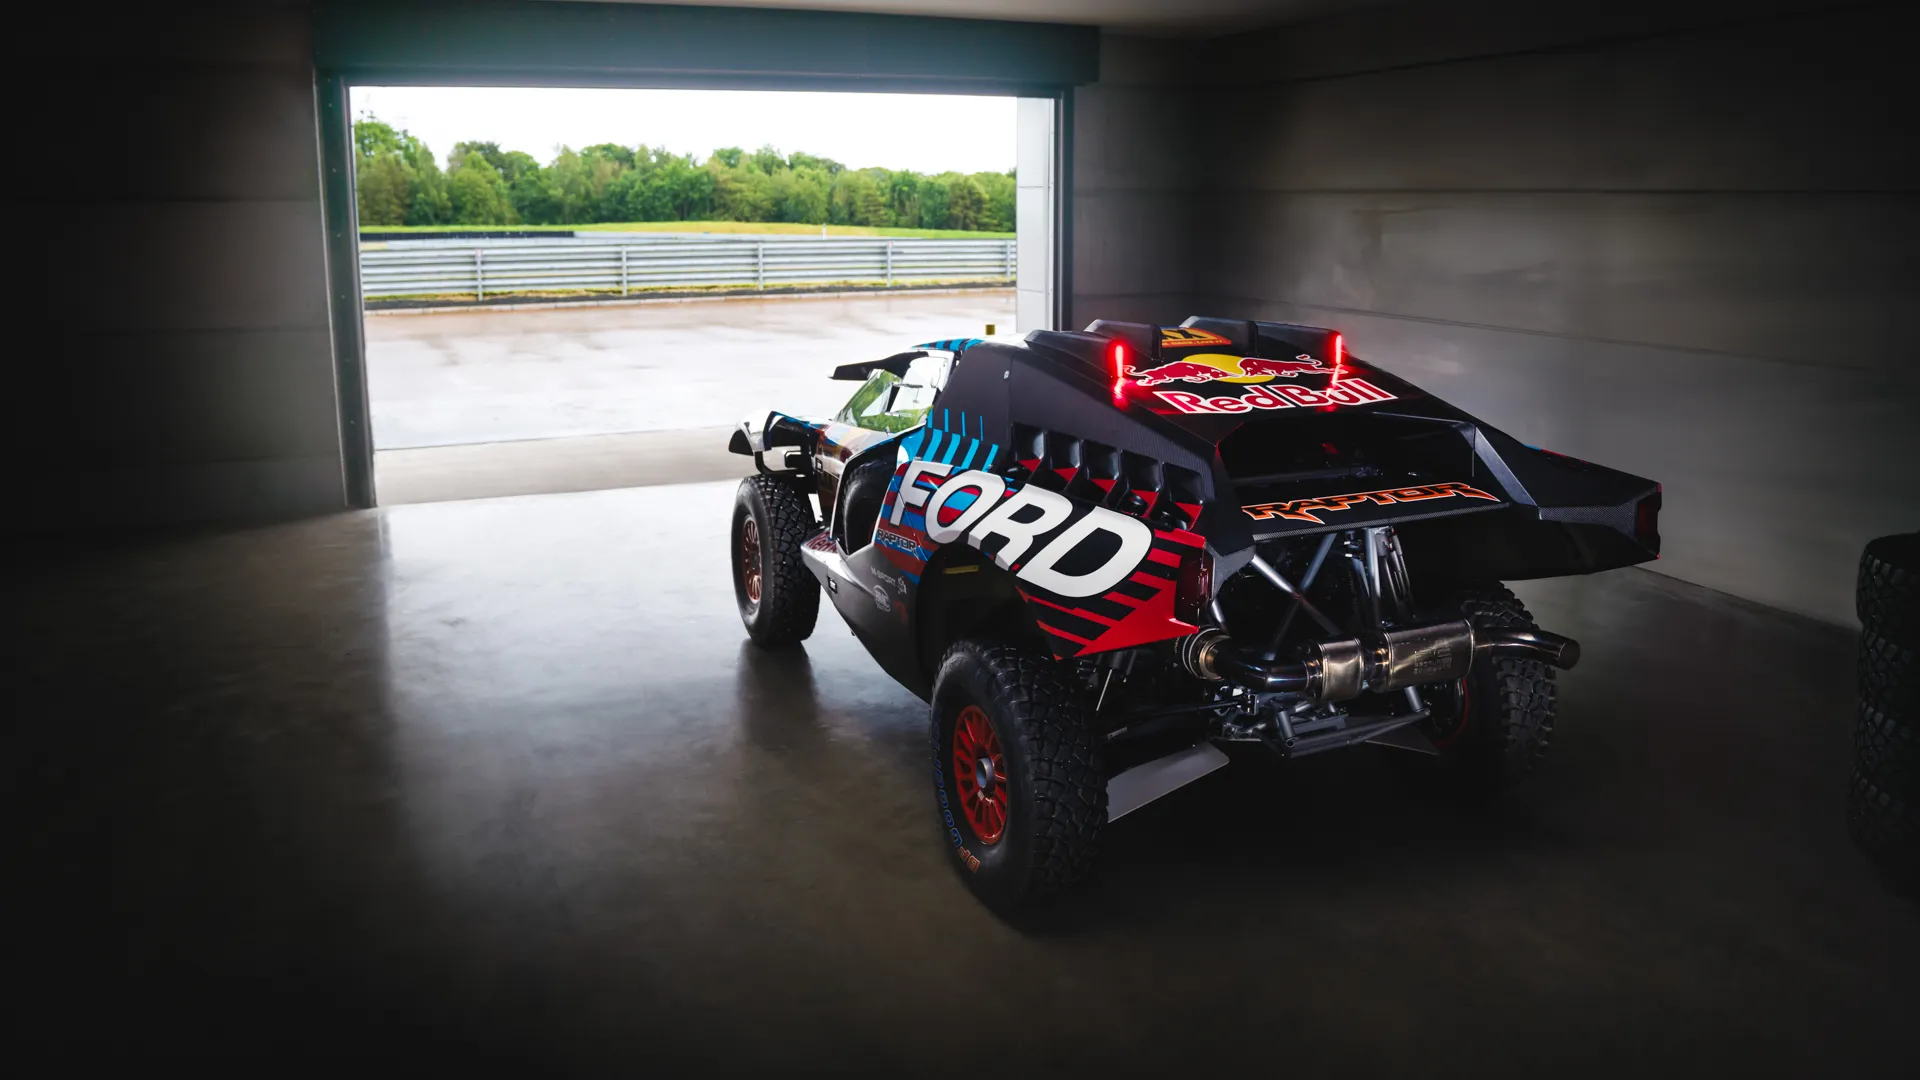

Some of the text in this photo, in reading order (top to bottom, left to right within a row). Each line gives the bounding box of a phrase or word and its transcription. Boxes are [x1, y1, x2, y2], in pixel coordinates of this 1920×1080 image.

[1152, 377, 1399, 414] Red Bull
[1241, 482, 1501, 524] RAPTOR
[877, 528, 920, 561] RAPTOR
[889, 460, 1153, 598] FORD
